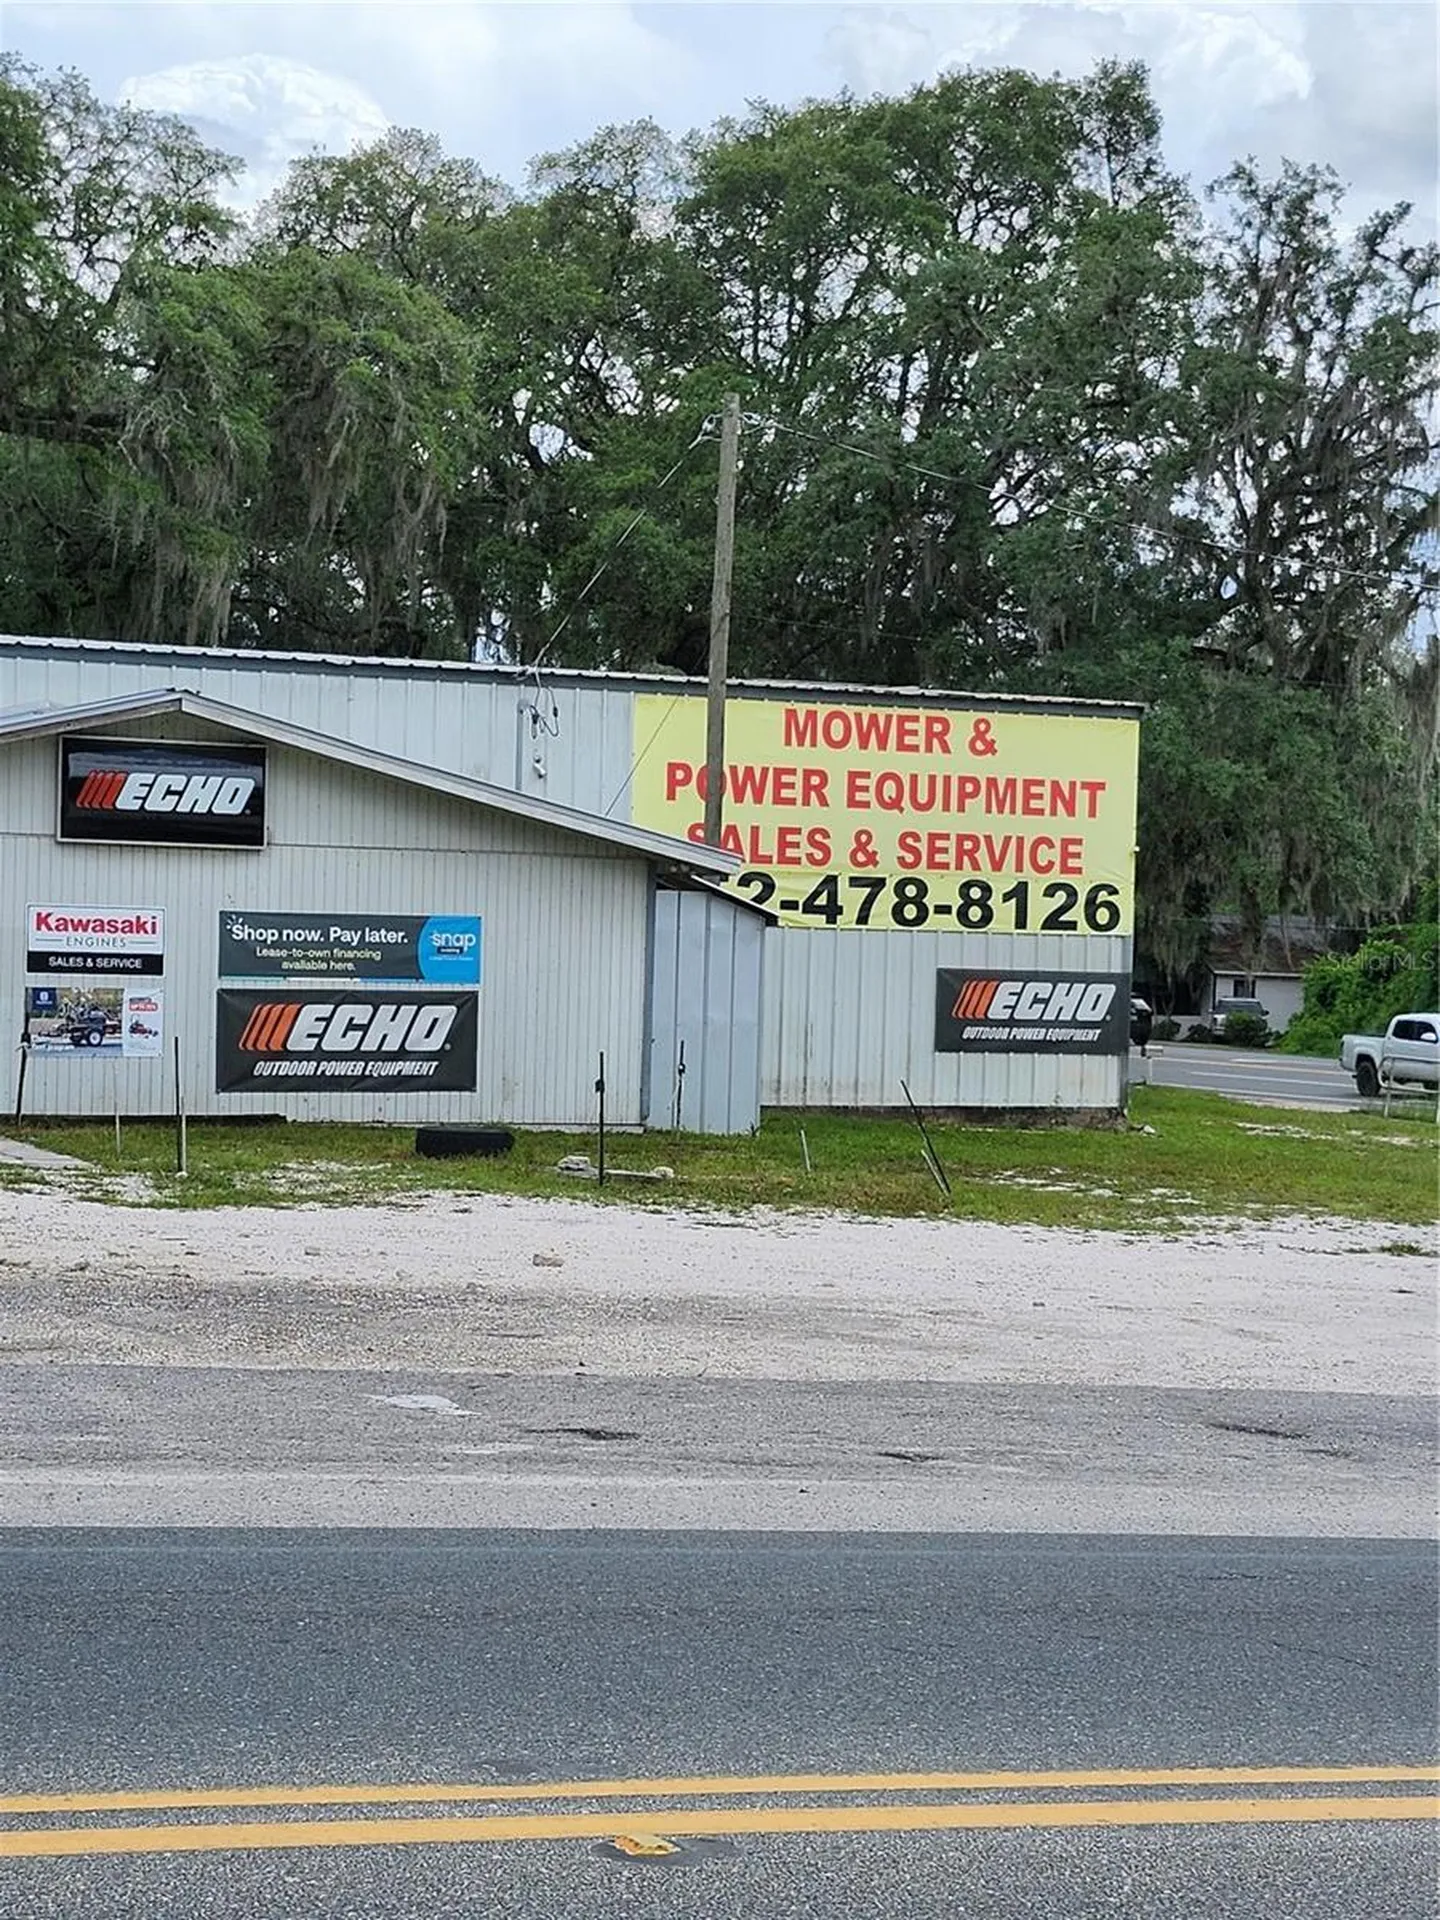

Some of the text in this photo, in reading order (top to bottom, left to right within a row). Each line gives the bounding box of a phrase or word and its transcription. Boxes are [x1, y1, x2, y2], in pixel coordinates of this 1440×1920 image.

[783, 708, 998, 757] MOWER &
[115, 772, 255, 815] ECHO
[666, 762, 1106, 818] POWER EQUIPMENT
[849, 829, 879, 869] &
[897, 831, 1084, 876] SERVICE
[36, 912, 157, 934] Kawasaki
[66, 936, 126, 948] ENGINES
[231, 924, 408, 946] Shop now. Pay later.
[431, 933, 476, 952] snap
[48, 956, 142, 969] SALES & SERVICE
[256, 946, 381, 961] Lease-to-own financing
[281, 959, 356, 971] available here.
[987, 981, 1116, 1021] ECHO
[285, 1004, 458, 1052] ECHO
[962, 1026, 1101, 1042] OUTDOOR POWER EQUIPMENT
[253, 1061, 439, 1077] OUTDOOR POWER EQUIPMENT
